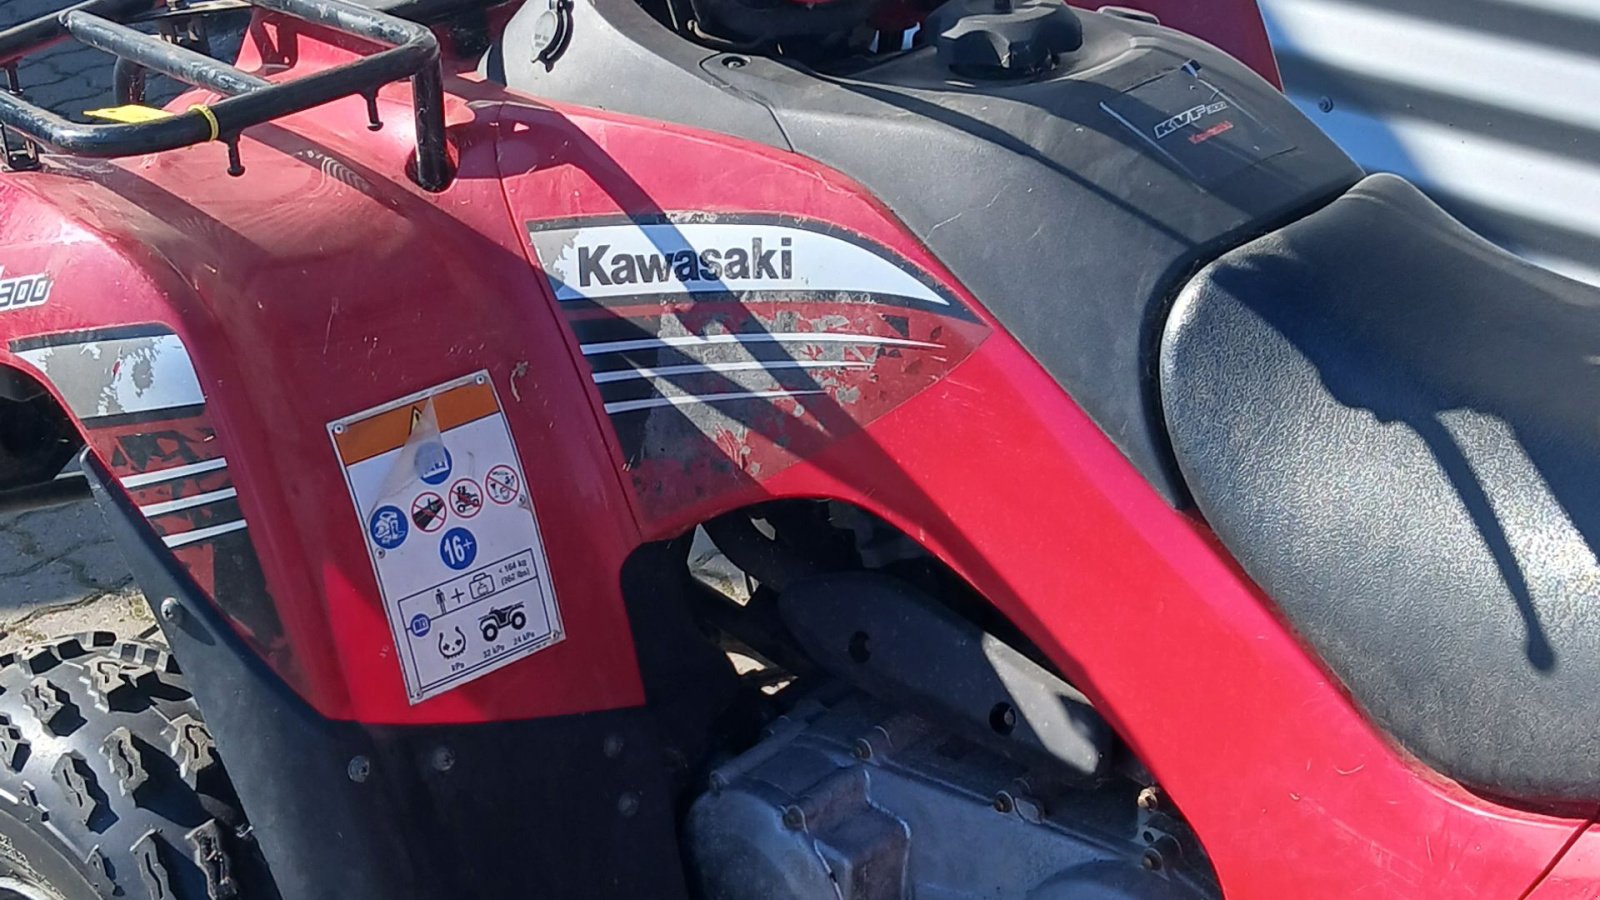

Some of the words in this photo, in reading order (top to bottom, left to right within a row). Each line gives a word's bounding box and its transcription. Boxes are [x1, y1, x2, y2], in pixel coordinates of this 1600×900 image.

[1154, 104, 1206, 139] KVF
[578, 237, 793, 287] Kawasaki
[0, 277, 50, 308] 300
[444, 535, 473, 565] 16+
[451, 661, 465, 672] kPa
